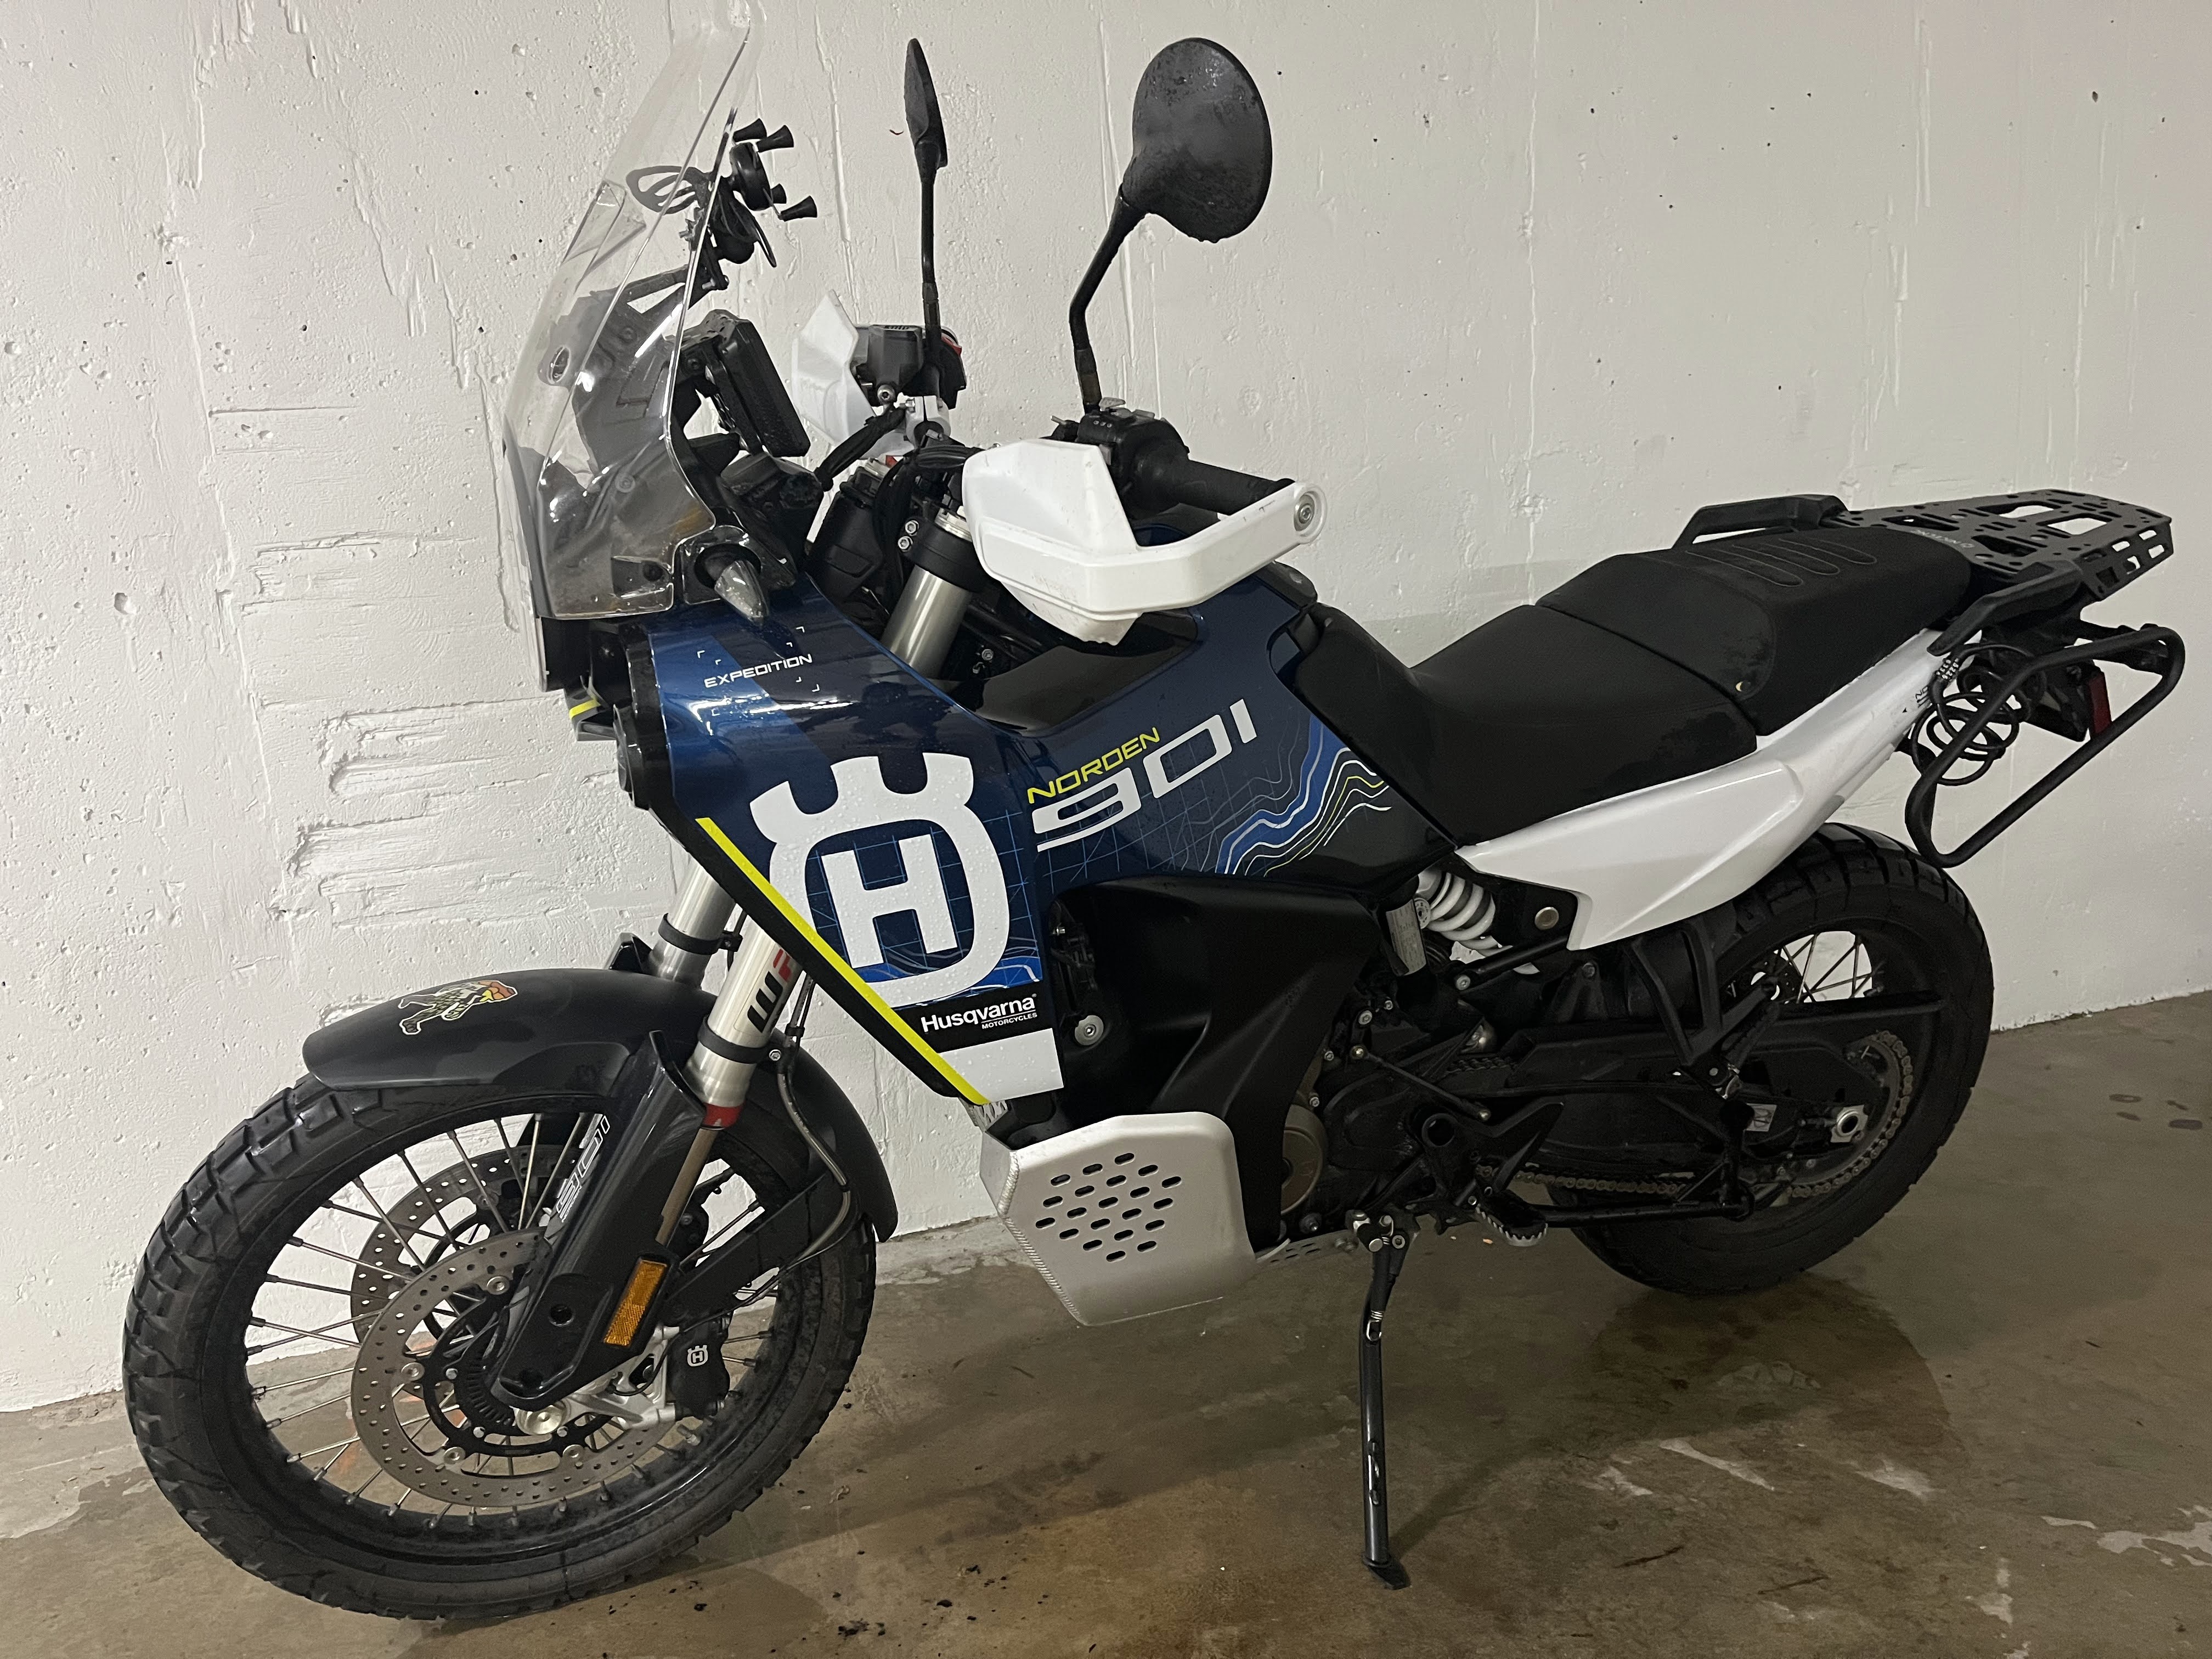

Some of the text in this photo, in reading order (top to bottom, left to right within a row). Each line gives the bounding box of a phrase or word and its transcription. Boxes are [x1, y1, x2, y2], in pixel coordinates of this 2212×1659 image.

[704, 653, 813, 688] EXPEDITION
[1027, 727, 1160, 804] NORDEN
[1032, 698, 1257, 852] 901
[921, 996, 1036, 1032] Husqvarna
[981, 1012, 1038, 1029] MOTORCYCLES
